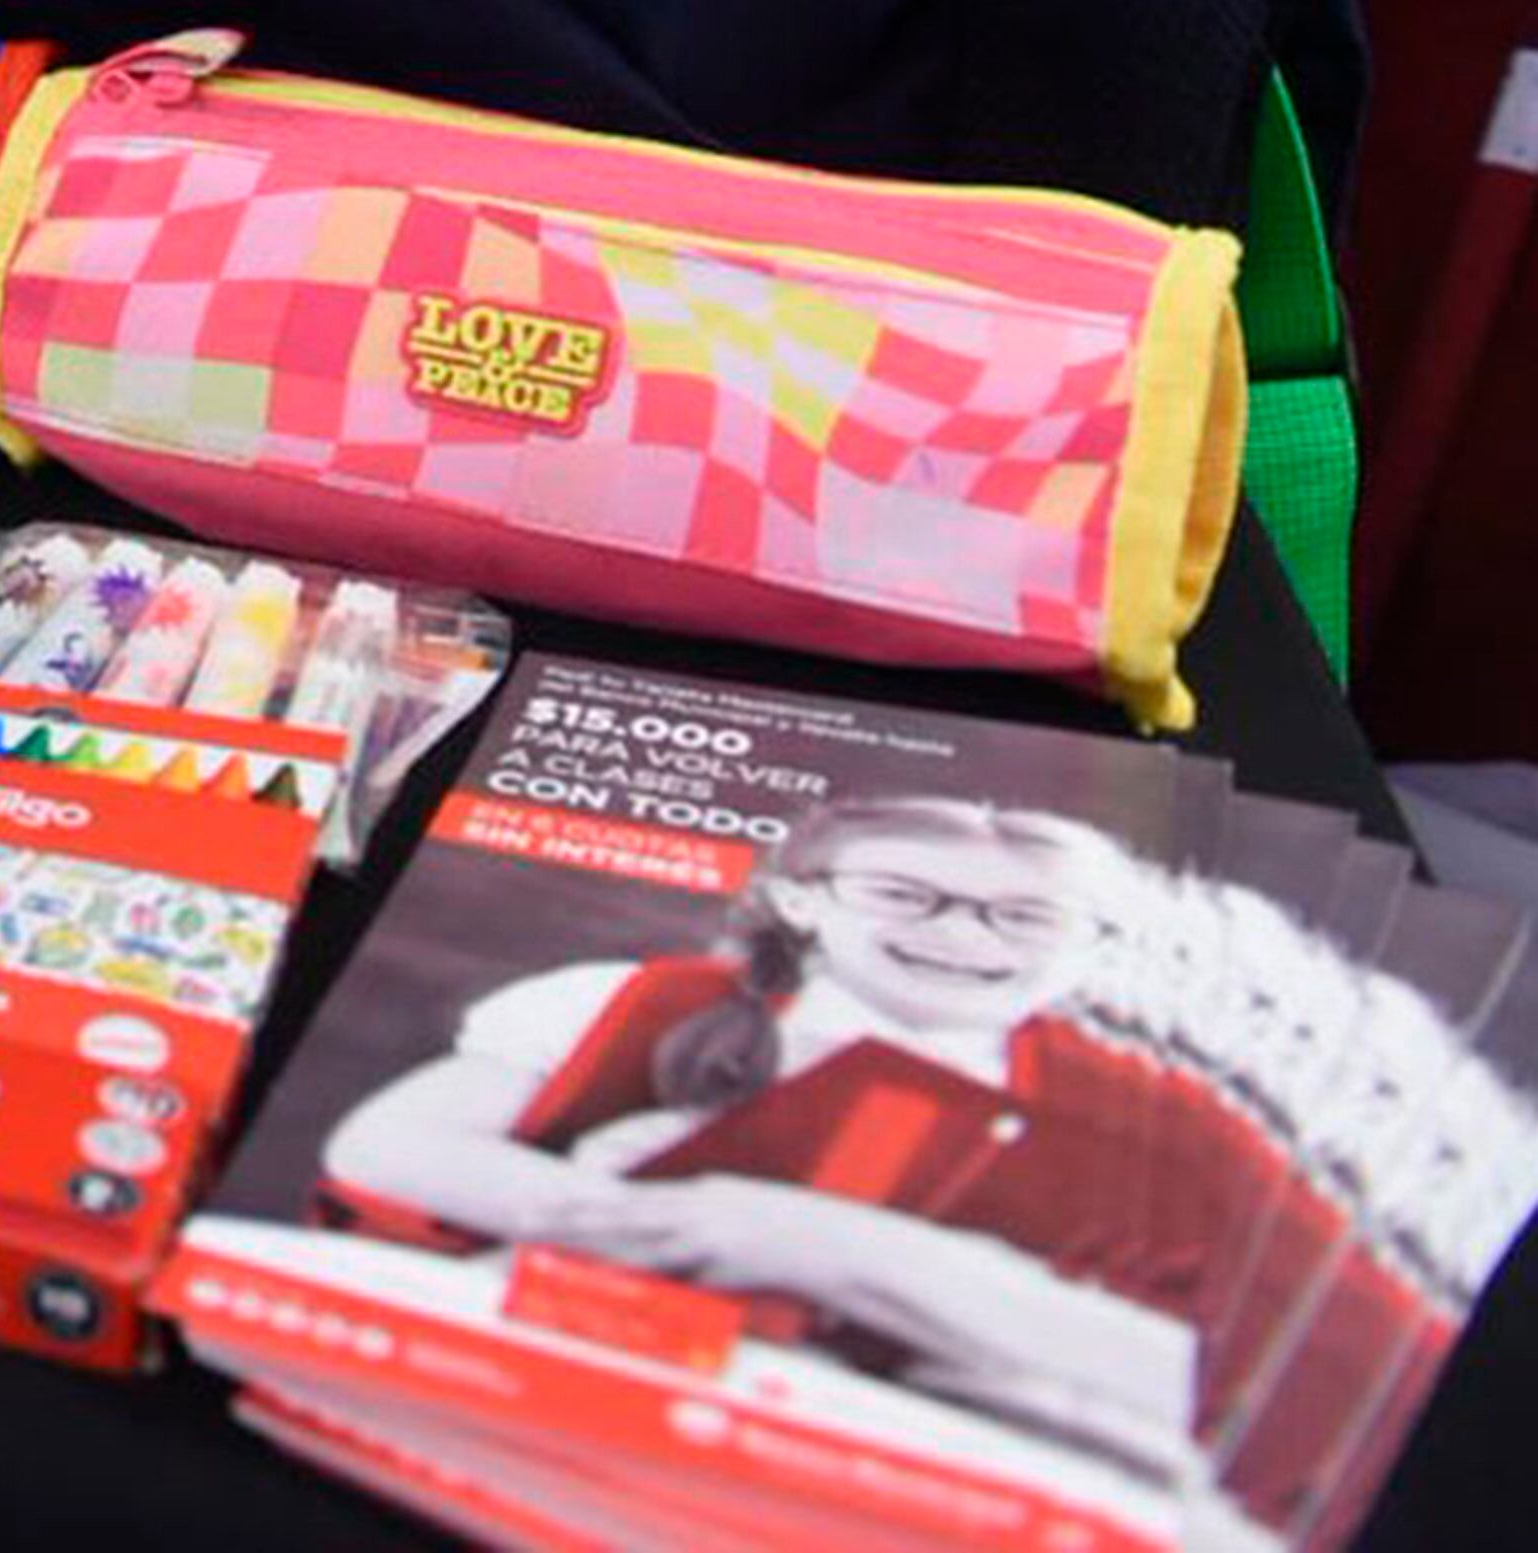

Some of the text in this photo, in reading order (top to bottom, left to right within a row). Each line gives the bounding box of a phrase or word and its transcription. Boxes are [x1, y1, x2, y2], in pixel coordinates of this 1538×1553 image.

[411, 295, 606, 376] LOVE
[417, 359, 575, 421] PEACE
[523, 697, 752, 756] $15.000
[497, 749, 715, 801] A CLASES
[511, 724, 831, 796] PARA VOLVER
[462, 822, 530, 850] SIN
[486, 769, 792, 843] CON TODO
